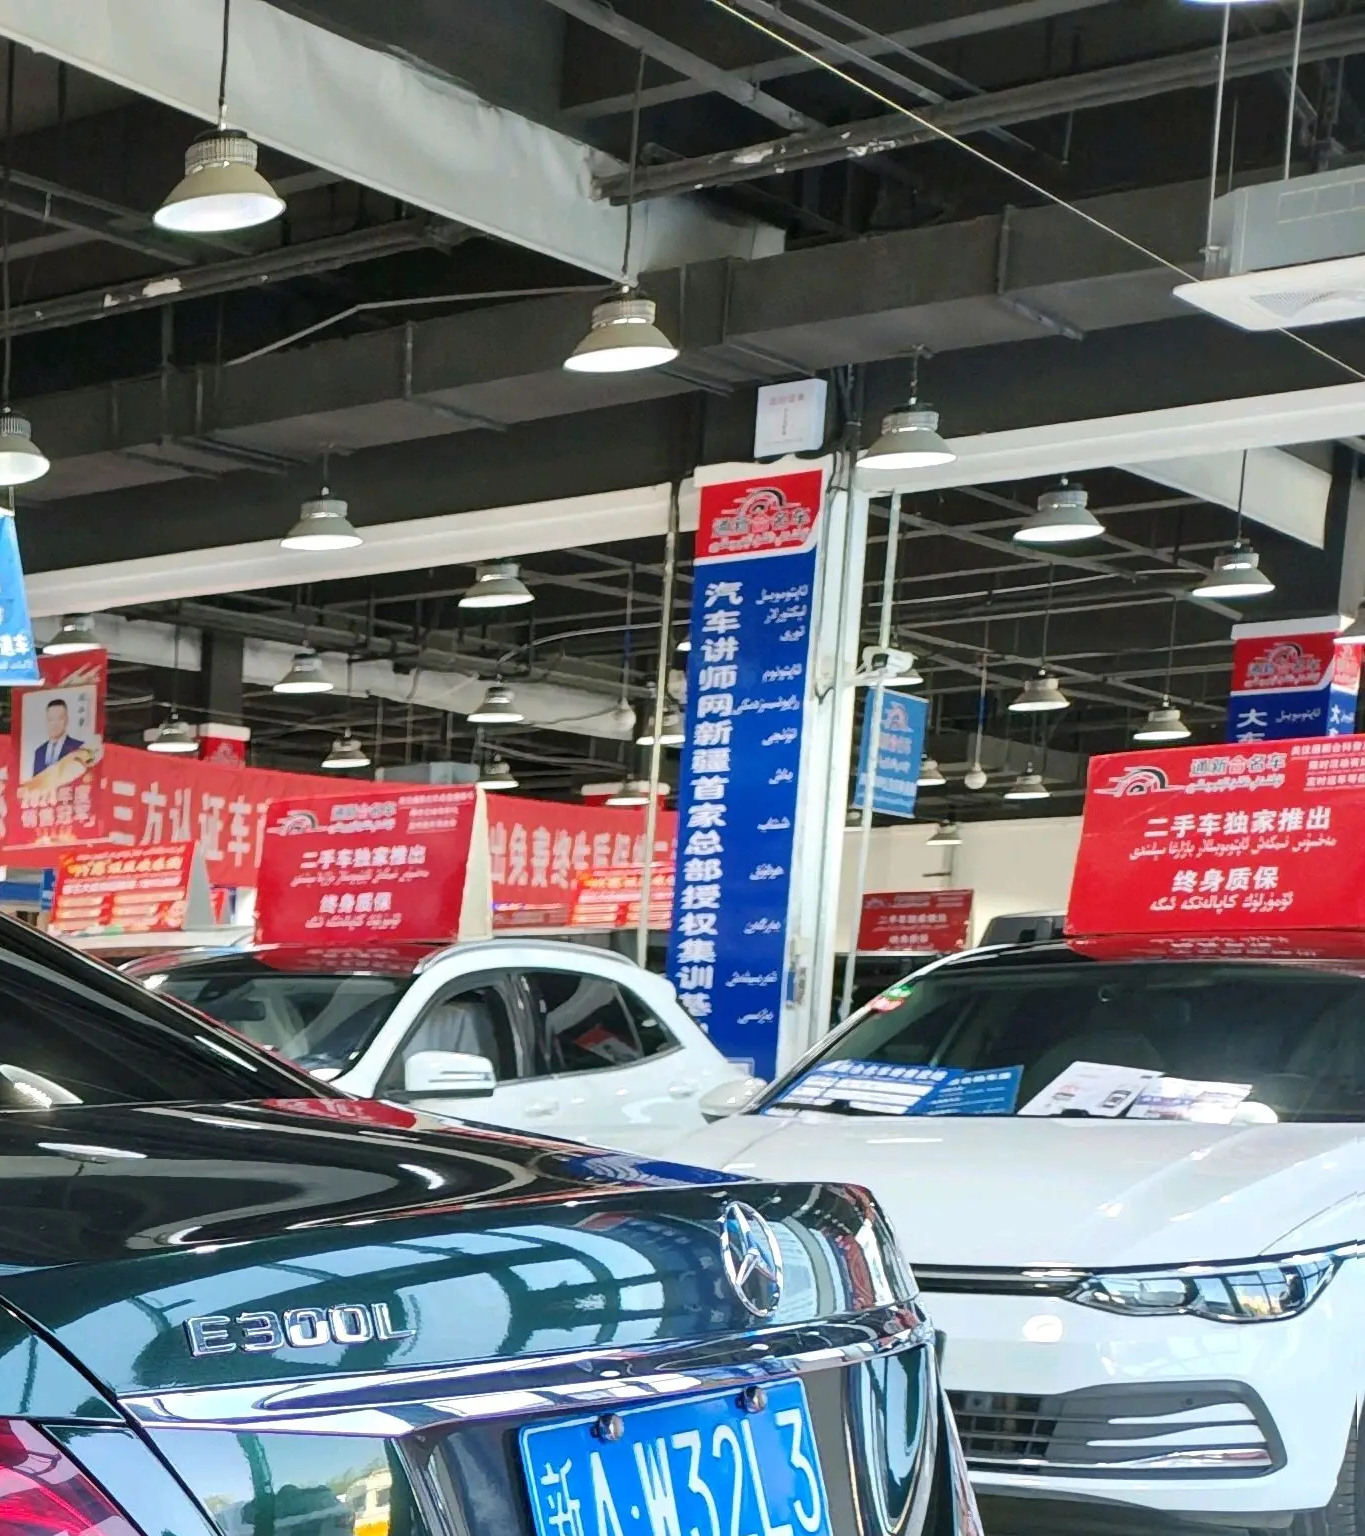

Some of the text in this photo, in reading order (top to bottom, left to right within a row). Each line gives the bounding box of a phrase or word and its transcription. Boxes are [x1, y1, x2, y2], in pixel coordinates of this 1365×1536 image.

[1143, 806, 1332, 839] 二手车独家推出
[1172, 866, 1279, 893] 终身质保
[183, 1302, 417, 1359] E300L
